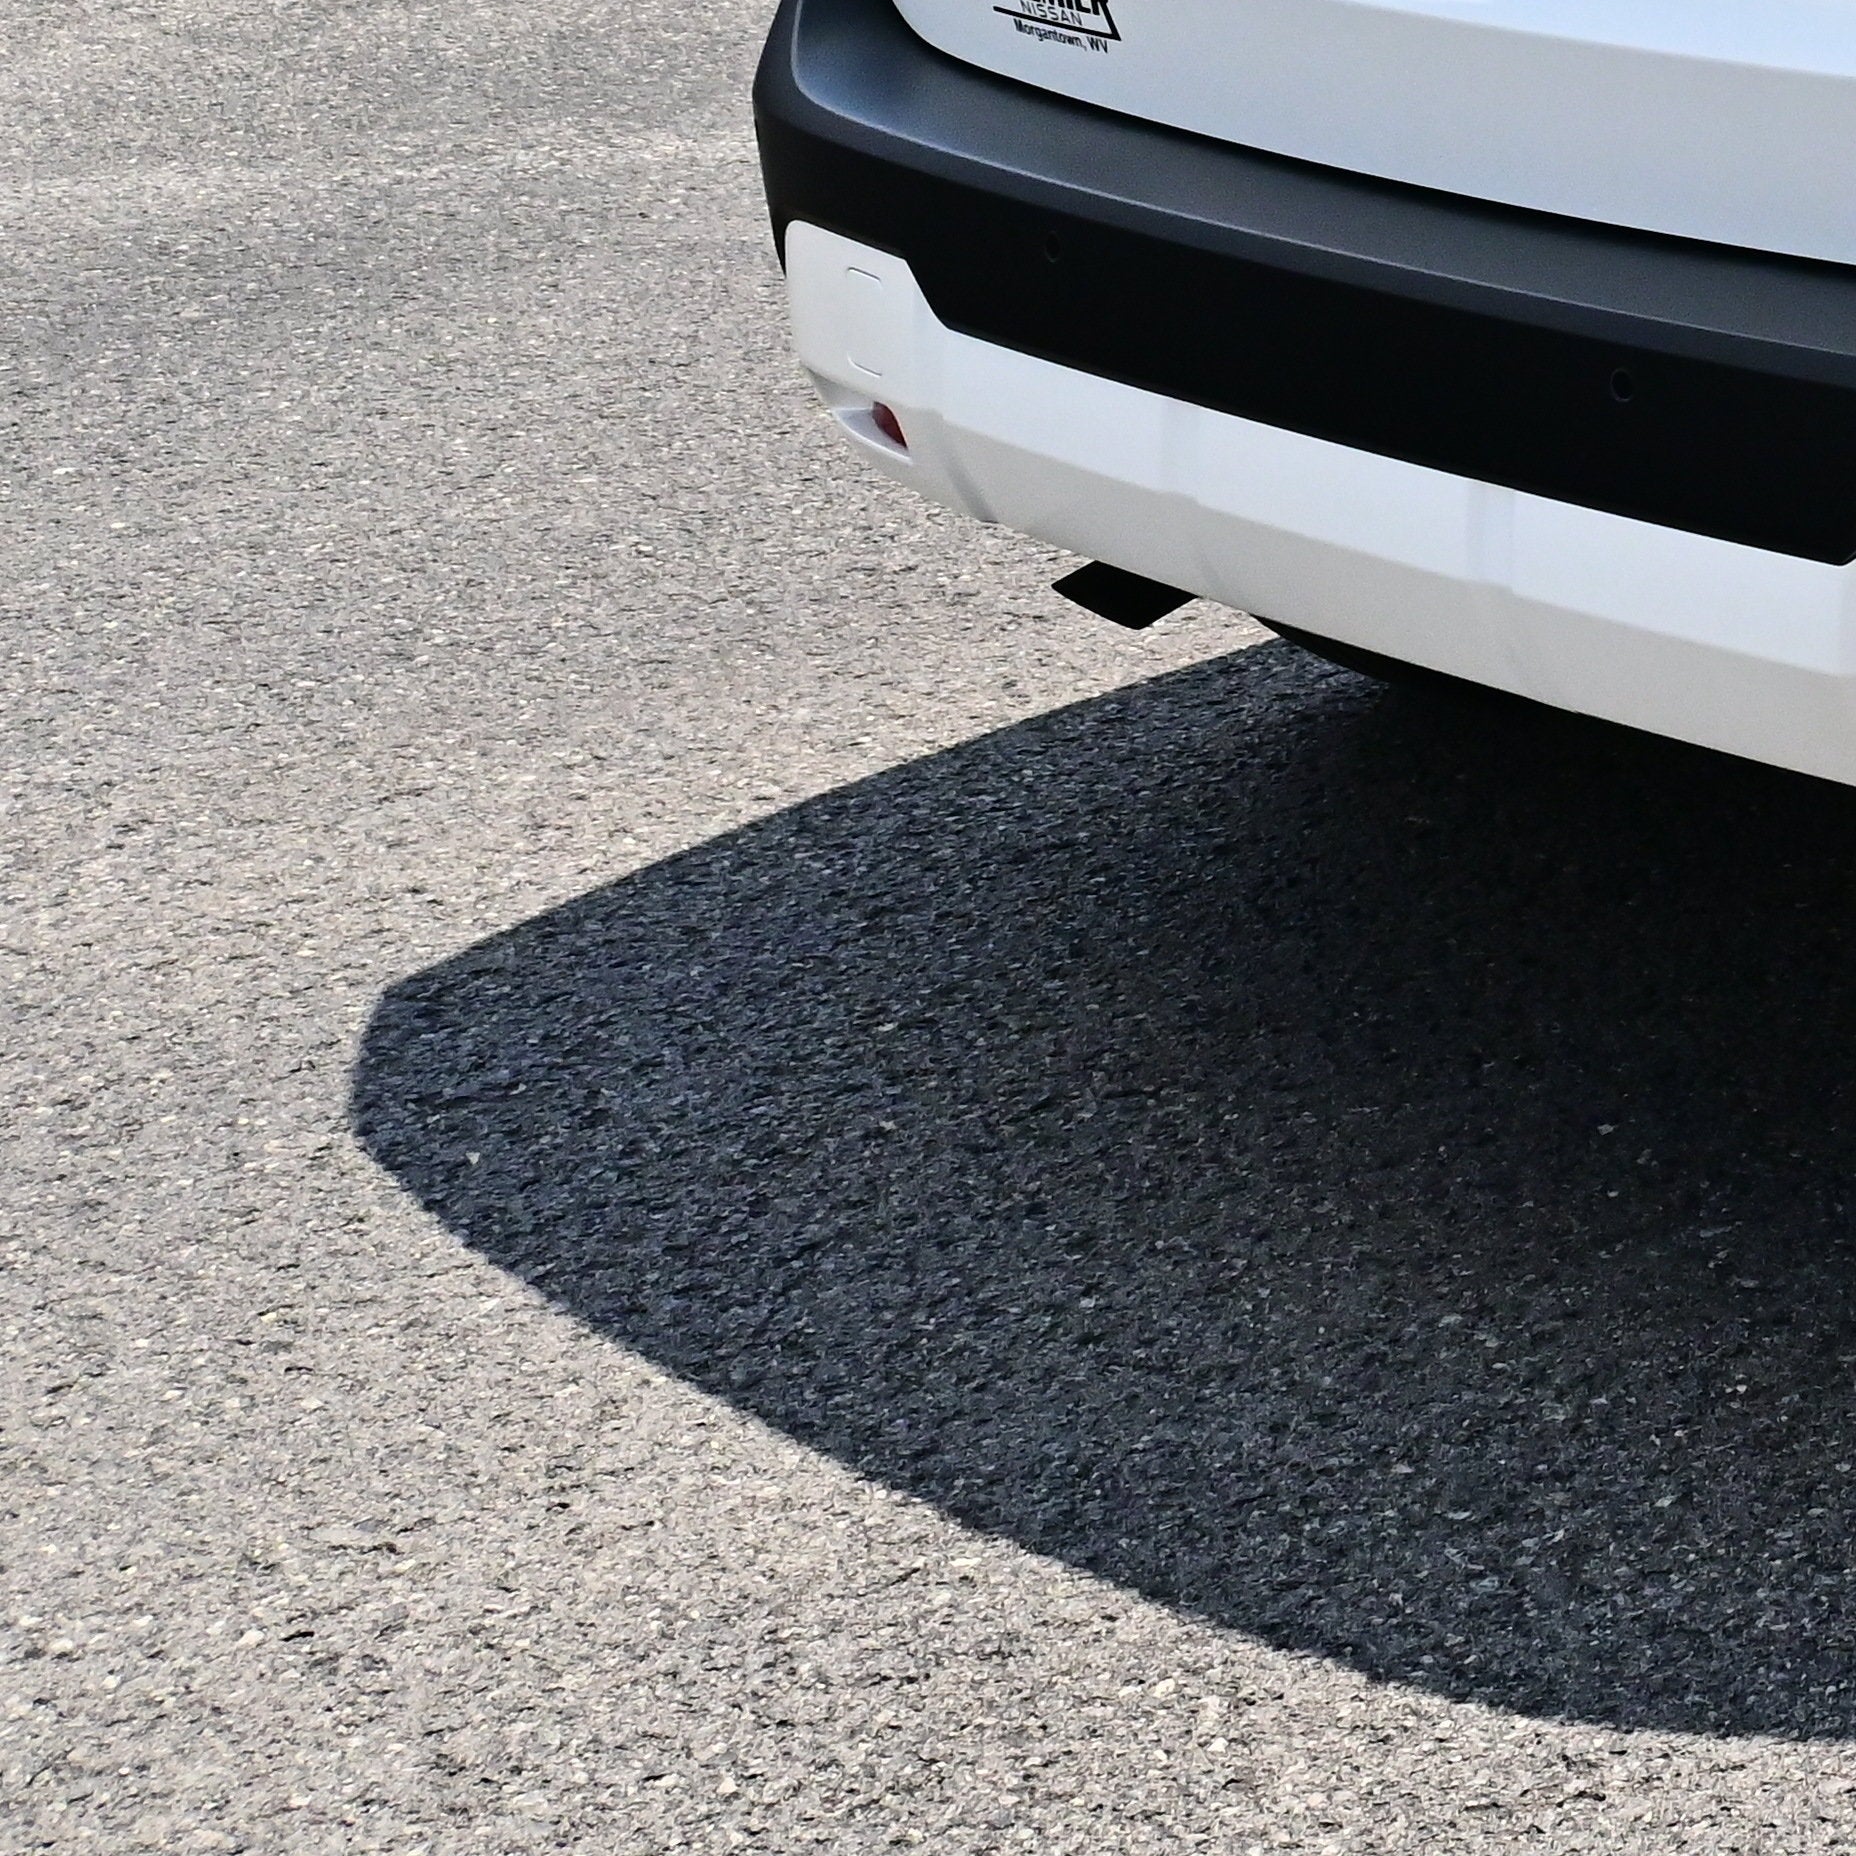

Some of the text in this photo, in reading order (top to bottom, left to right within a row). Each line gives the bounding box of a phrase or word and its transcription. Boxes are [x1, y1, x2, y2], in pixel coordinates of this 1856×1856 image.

[1020, 0, 1083, 26] NISSAN
[1013, 18, 1108, 53] Morgantown, WV
